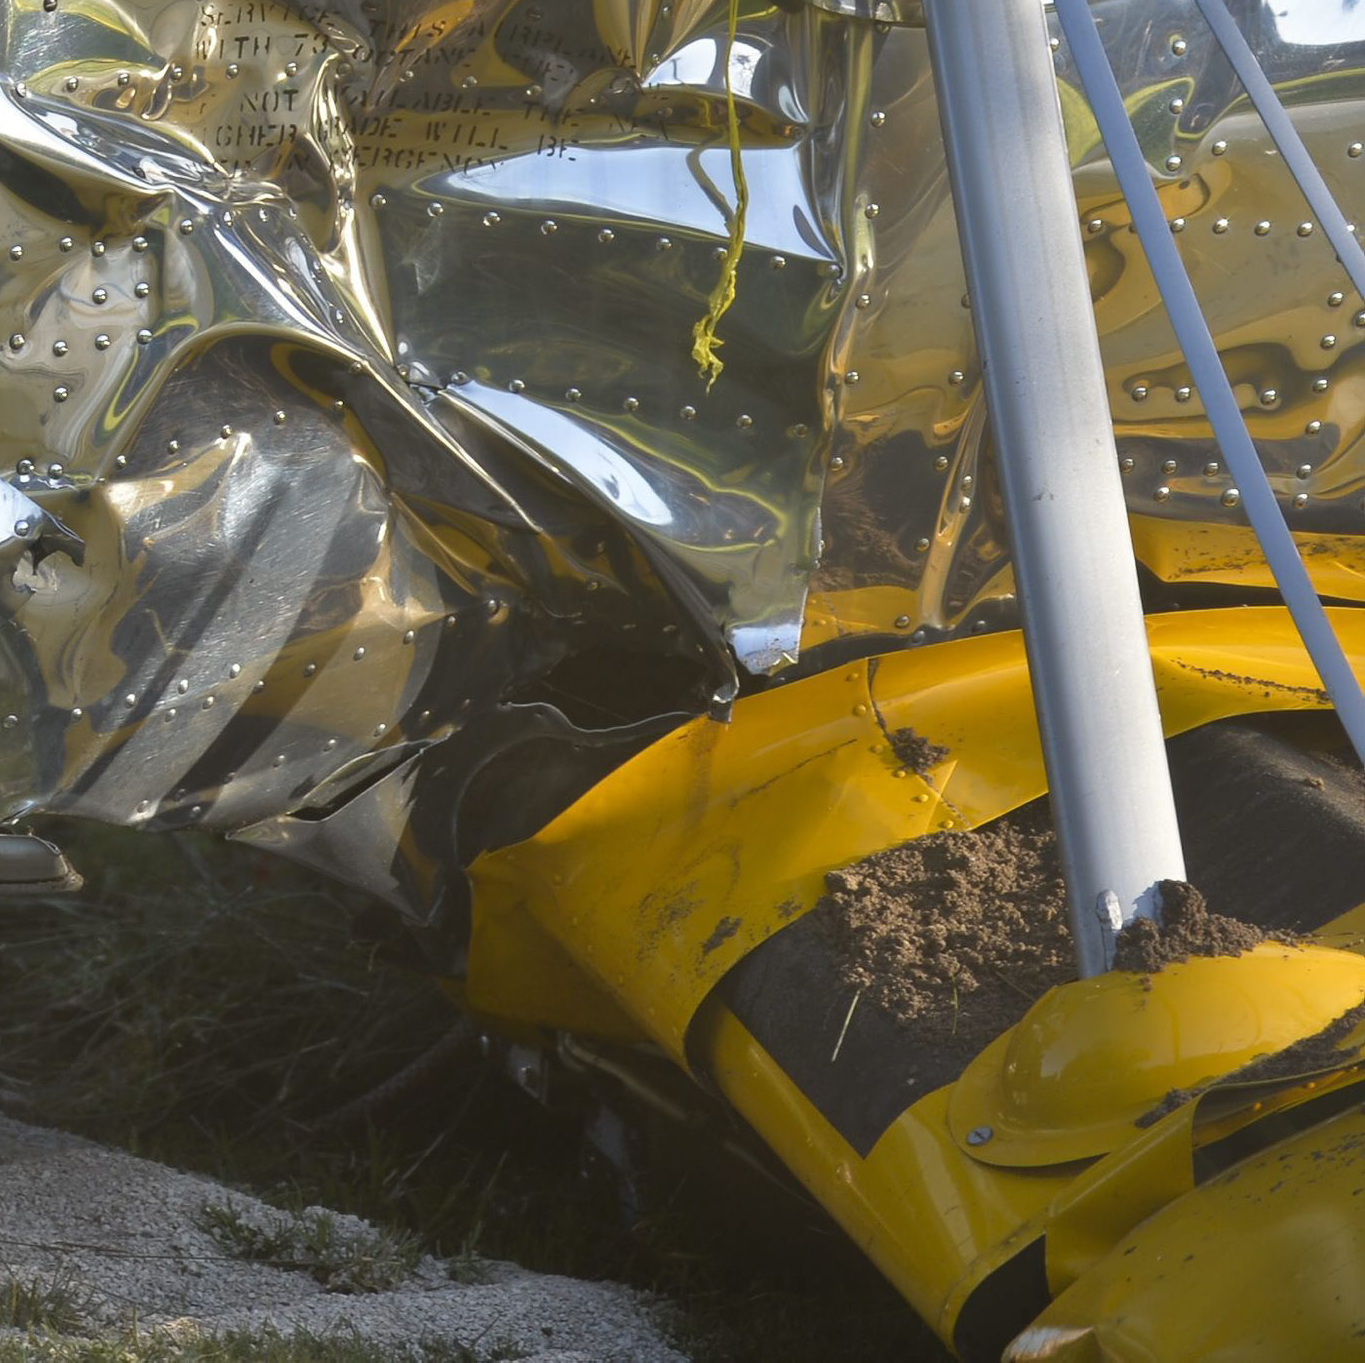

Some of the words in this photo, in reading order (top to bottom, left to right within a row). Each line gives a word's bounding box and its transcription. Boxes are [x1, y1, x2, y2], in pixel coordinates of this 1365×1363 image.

[195, 35, 271, 61] WITH
[239, 89, 298, 113] NOT
[426, 121, 508, 151] WILL
[537, 133, 578, 162] BE
